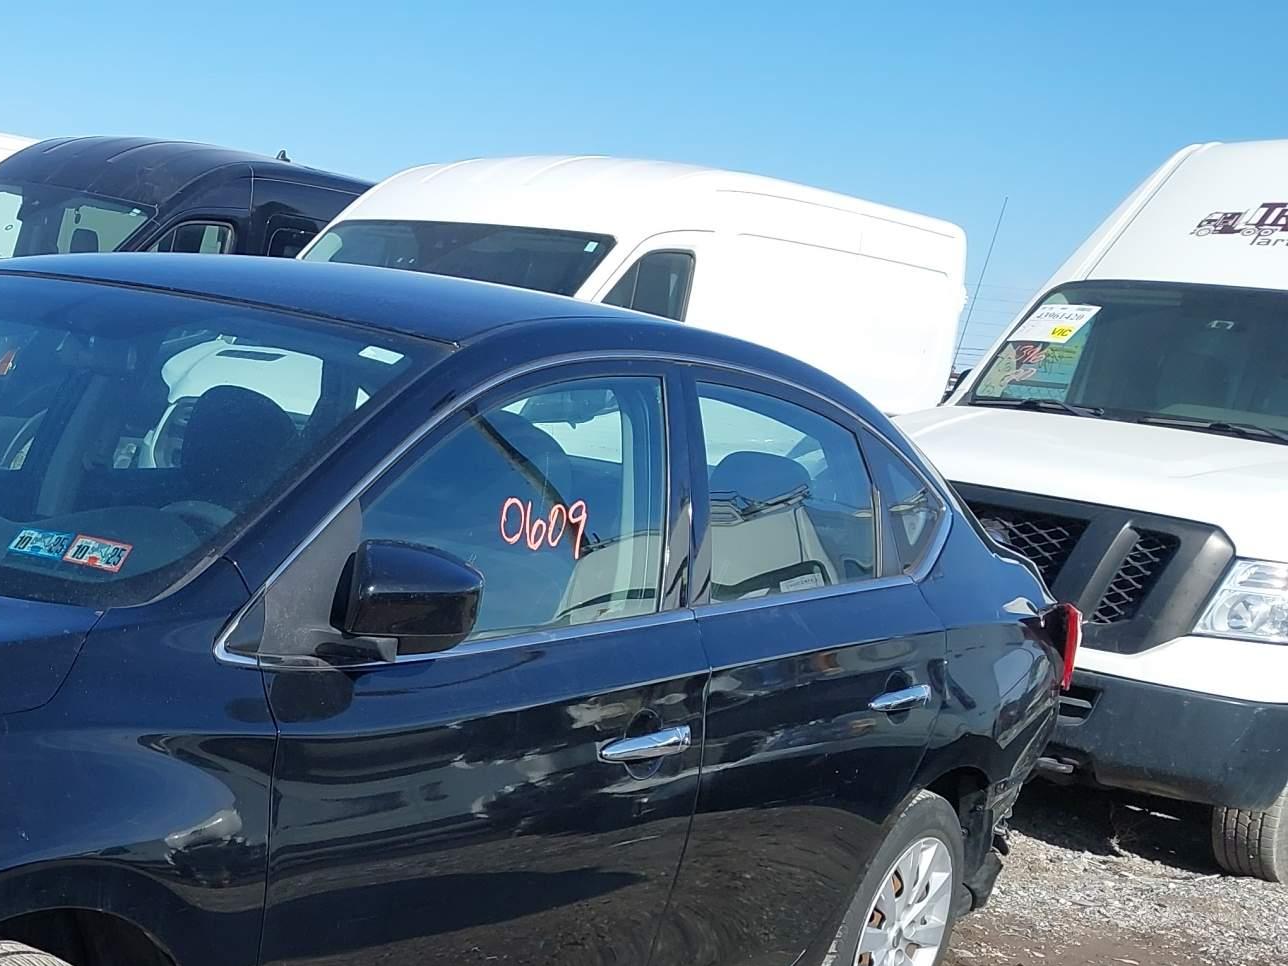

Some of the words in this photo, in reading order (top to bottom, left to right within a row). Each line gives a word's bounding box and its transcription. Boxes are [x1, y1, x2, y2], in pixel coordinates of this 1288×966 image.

[1051, 327, 1073, 337] VIC
[500, 497, 588, 561] 0609
[14, 534, 33, 550] 10
[71, 543, 90, 560] 10
[106, 546, 127, 566] 25
